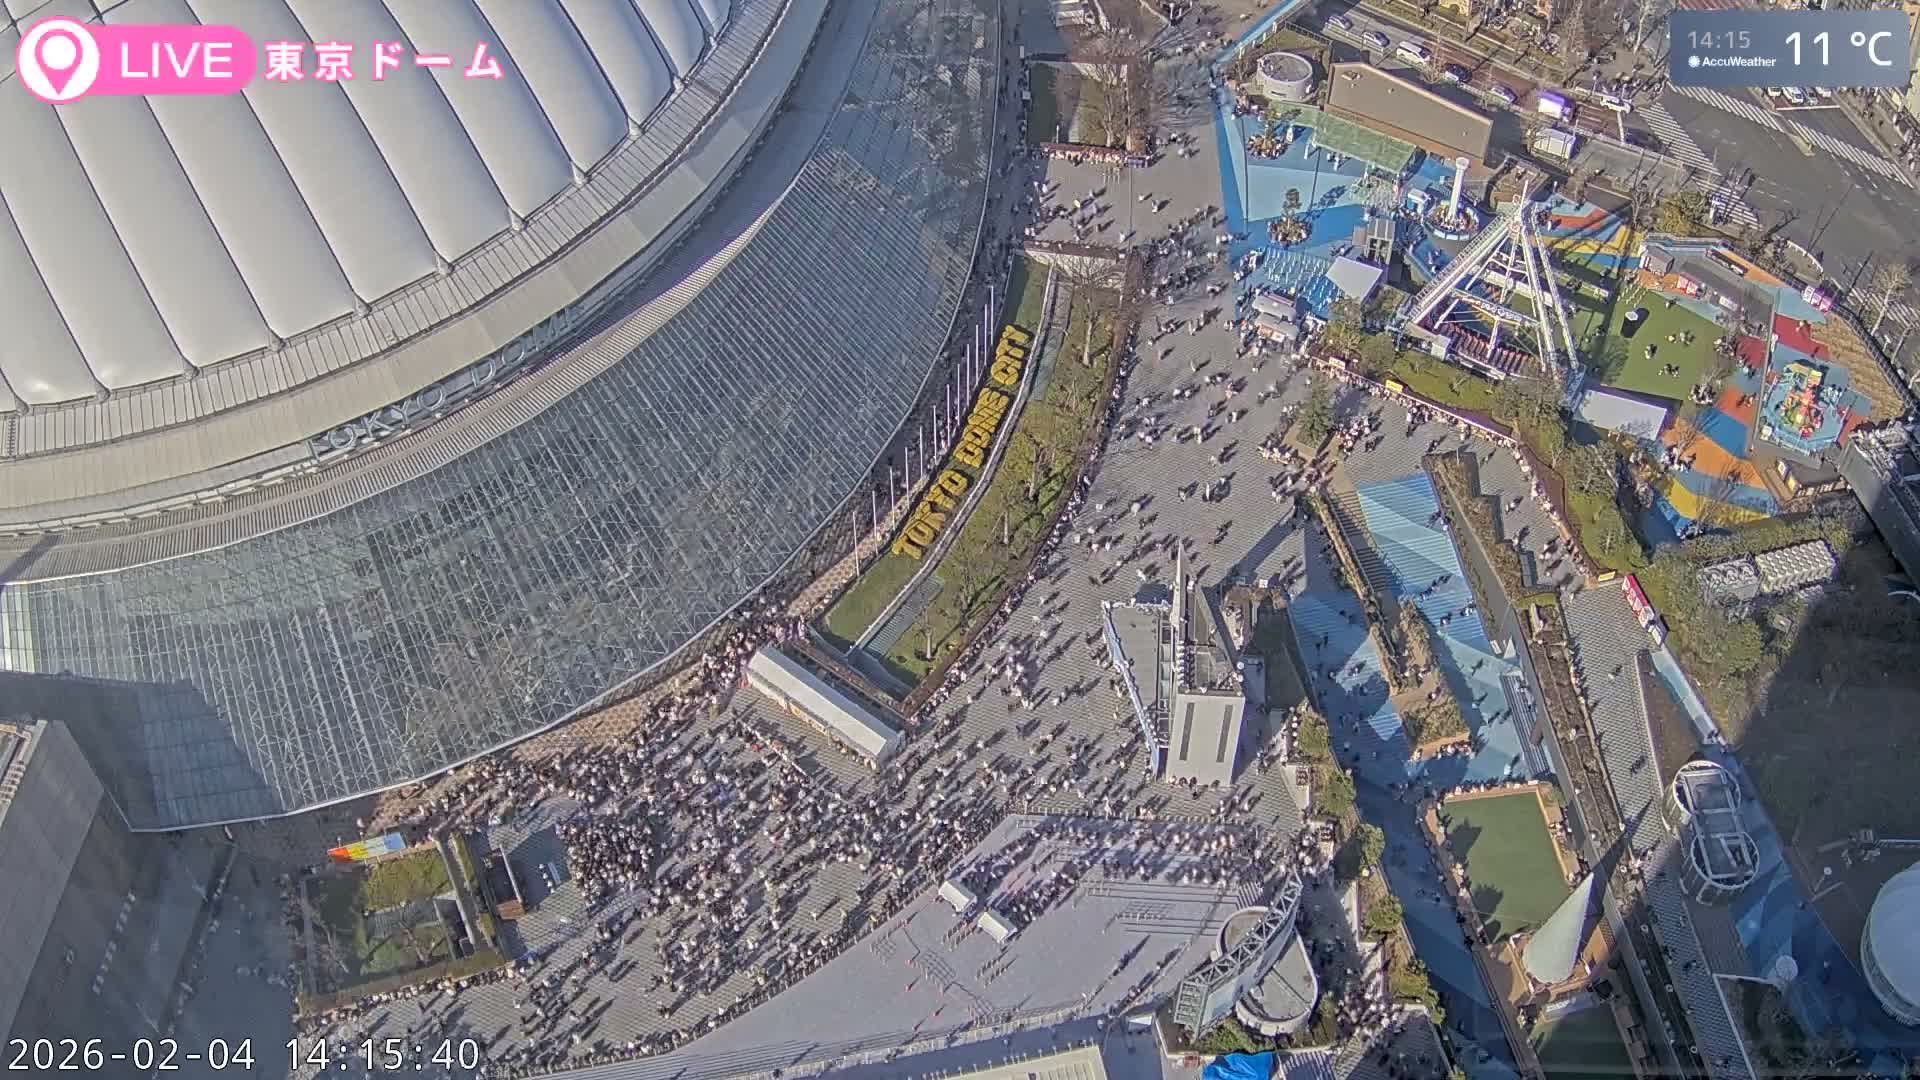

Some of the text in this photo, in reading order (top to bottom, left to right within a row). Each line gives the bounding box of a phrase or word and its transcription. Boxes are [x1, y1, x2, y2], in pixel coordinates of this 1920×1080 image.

[892, 324, 1030, 561] TOKYO DOME CITY
